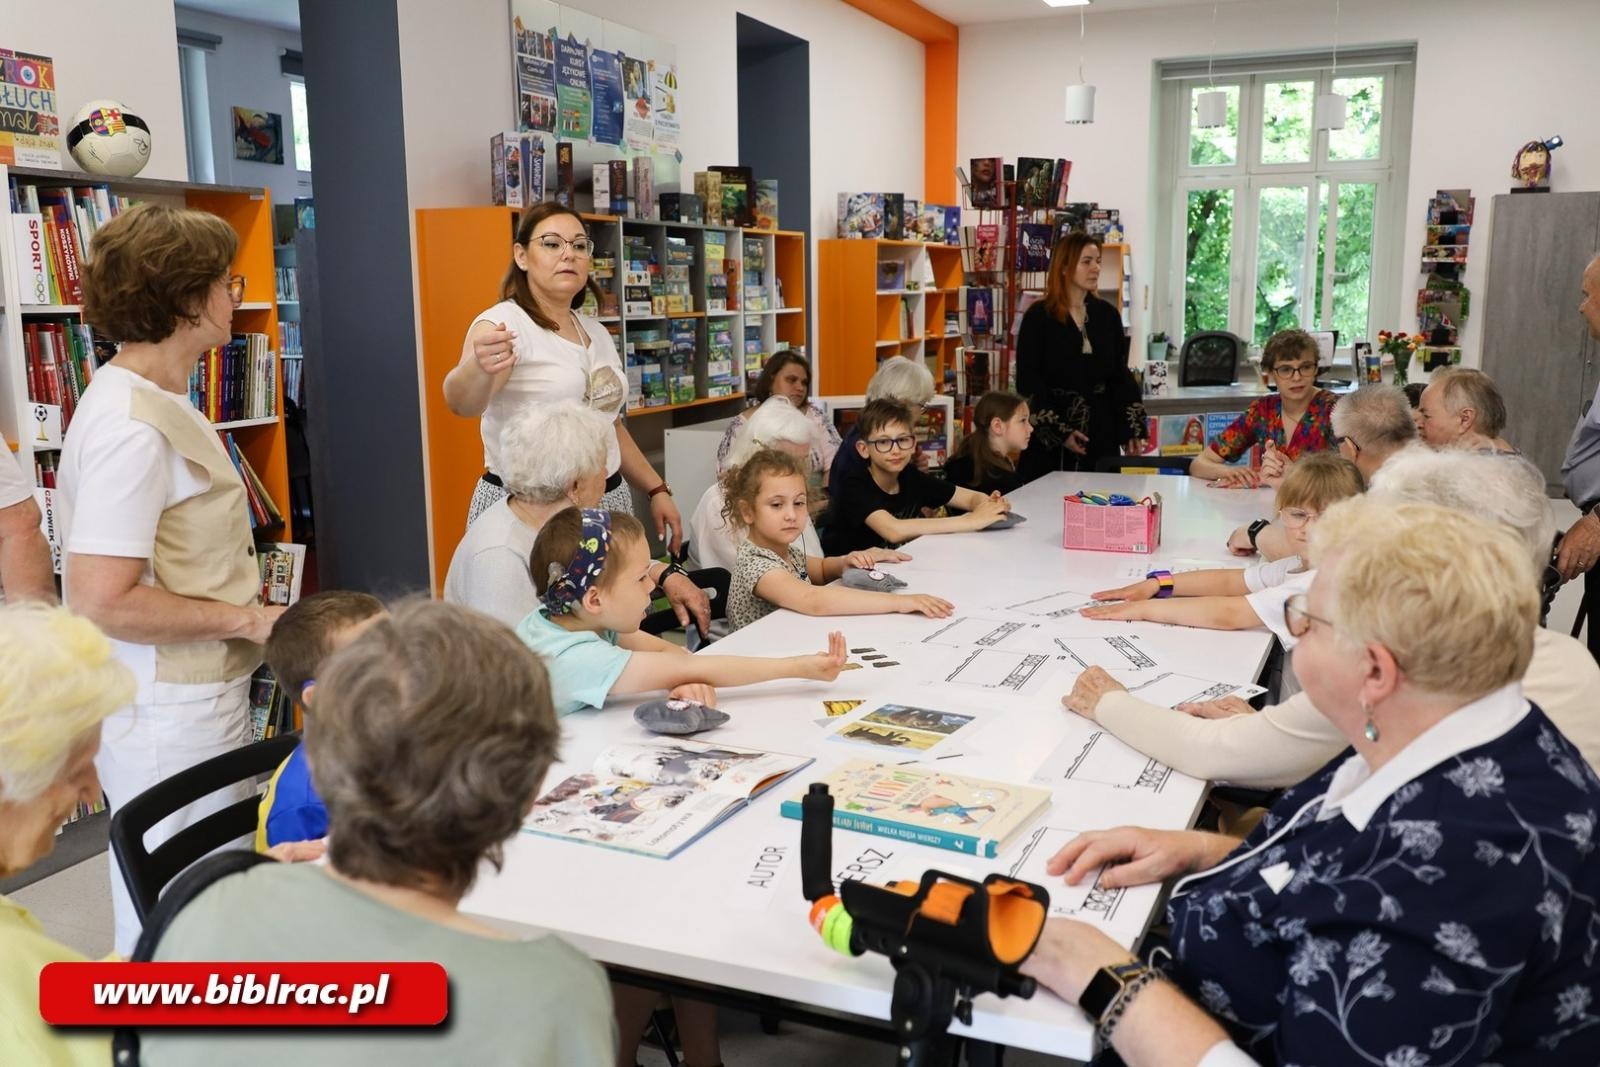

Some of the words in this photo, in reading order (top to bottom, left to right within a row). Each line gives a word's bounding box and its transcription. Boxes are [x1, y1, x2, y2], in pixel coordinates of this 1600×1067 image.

[0, 59, 50, 89] ROK
[569, 79, 586, 88] ONLINE
[0, 85, 53, 113] ŁUCH
[29, 219, 42, 273] SPORT
[45, 490, 55, 541] CZŁOWIEK
[747, 846, 788, 889] AUTOR
